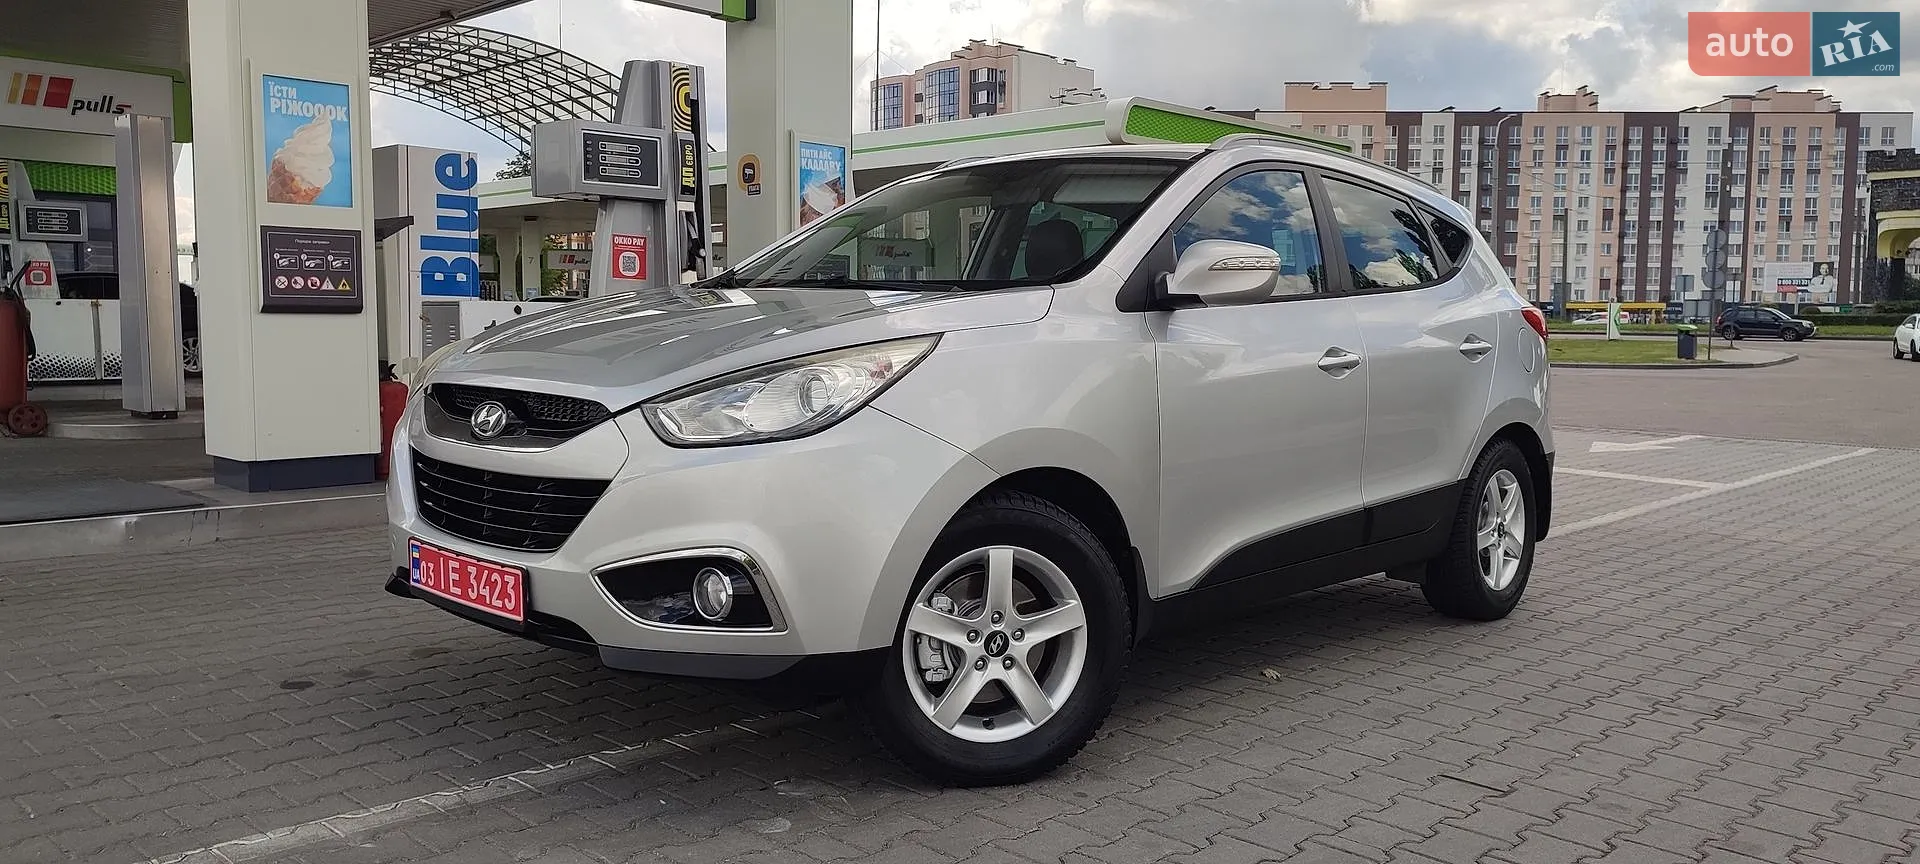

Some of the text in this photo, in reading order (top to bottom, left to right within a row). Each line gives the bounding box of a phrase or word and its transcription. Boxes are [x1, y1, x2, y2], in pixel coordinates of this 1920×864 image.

[268, 81, 297, 99] ЇСТИ
[71, 94, 132, 116] pulls
[270, 97, 348, 122] РІЖОООК
[420, 153, 480, 298] Blue
[614, 236, 645, 246] OKKO PAY
[413, 557, 515, 610] UA 03 IE 3423
